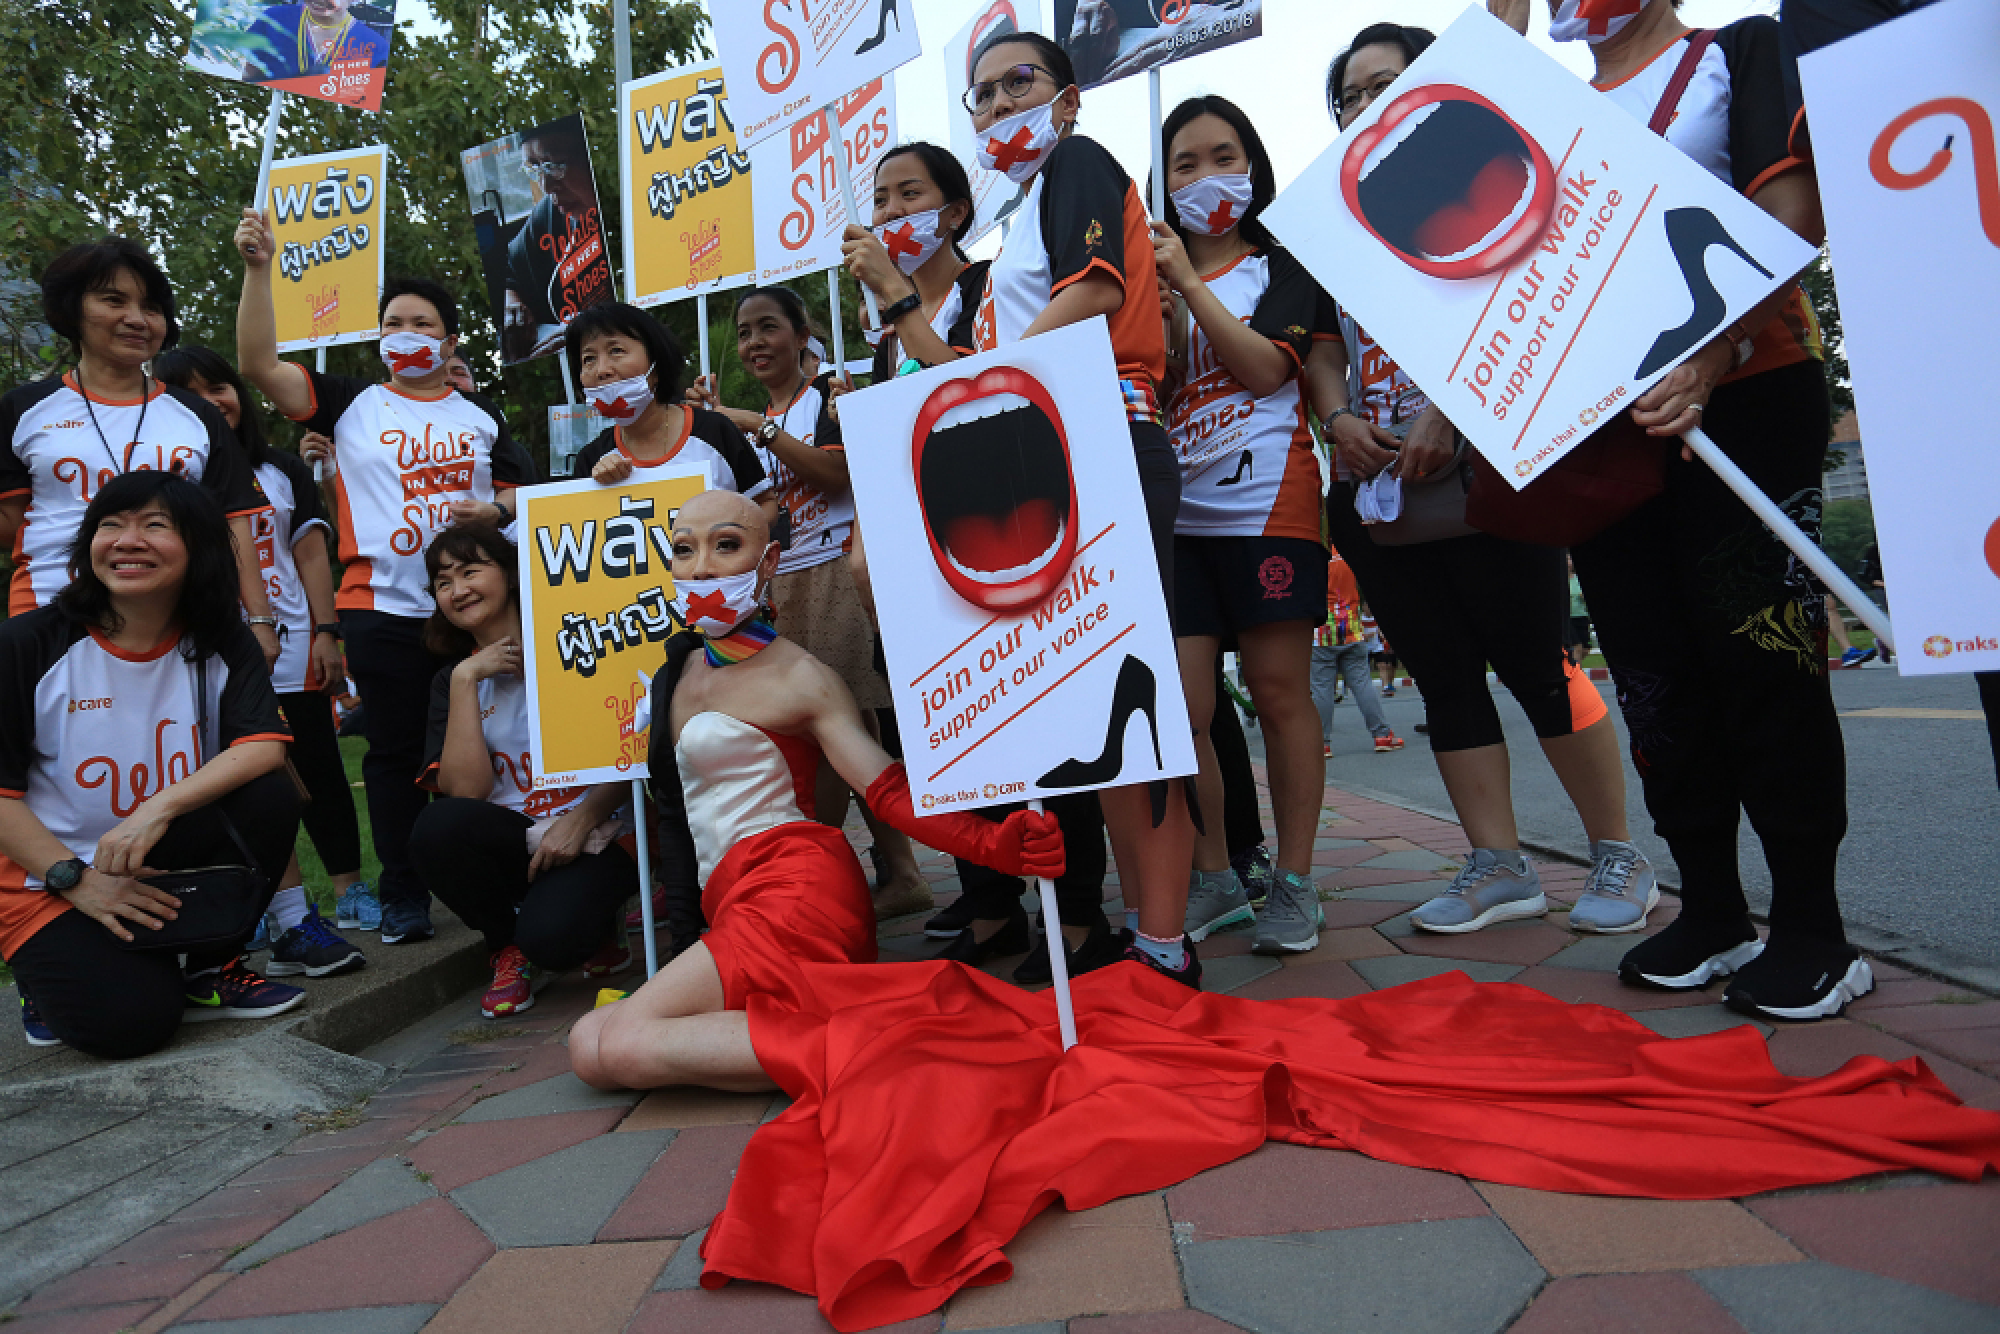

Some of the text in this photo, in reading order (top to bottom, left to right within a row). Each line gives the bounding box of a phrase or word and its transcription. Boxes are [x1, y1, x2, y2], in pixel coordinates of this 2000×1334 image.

[319, 69, 371, 97] Shoes
[796, 115, 821, 153] IN
[272, 165, 375, 225] พลัง
[279, 223, 370, 283] ผู้หญิง
[559, 259, 609, 325] Shoes
[1463, 330, 1512, 408] join
[1507, 260, 1545, 324] our
[1540, 170, 1597, 255] walk
[1493, 189, 1623, 421] support our voice
[379, 422, 475, 471] Walk
[1171, 400, 1255, 457] hoes
[1531, 444, 1555, 465] raks
[1596, 385, 1628, 412] care
[52, 441, 192, 503] Wlk
[921, 666, 973, 729] join
[979, 622, 1024, 673] our
[1031, 564, 1101, 632] walk
[1955, 635, 1999, 653] raks
[77, 697, 113, 711] care
[929, 601, 1110, 750] support our voice
[74, 717, 202, 819] Wal
[999, 781, 1026, 795] care
